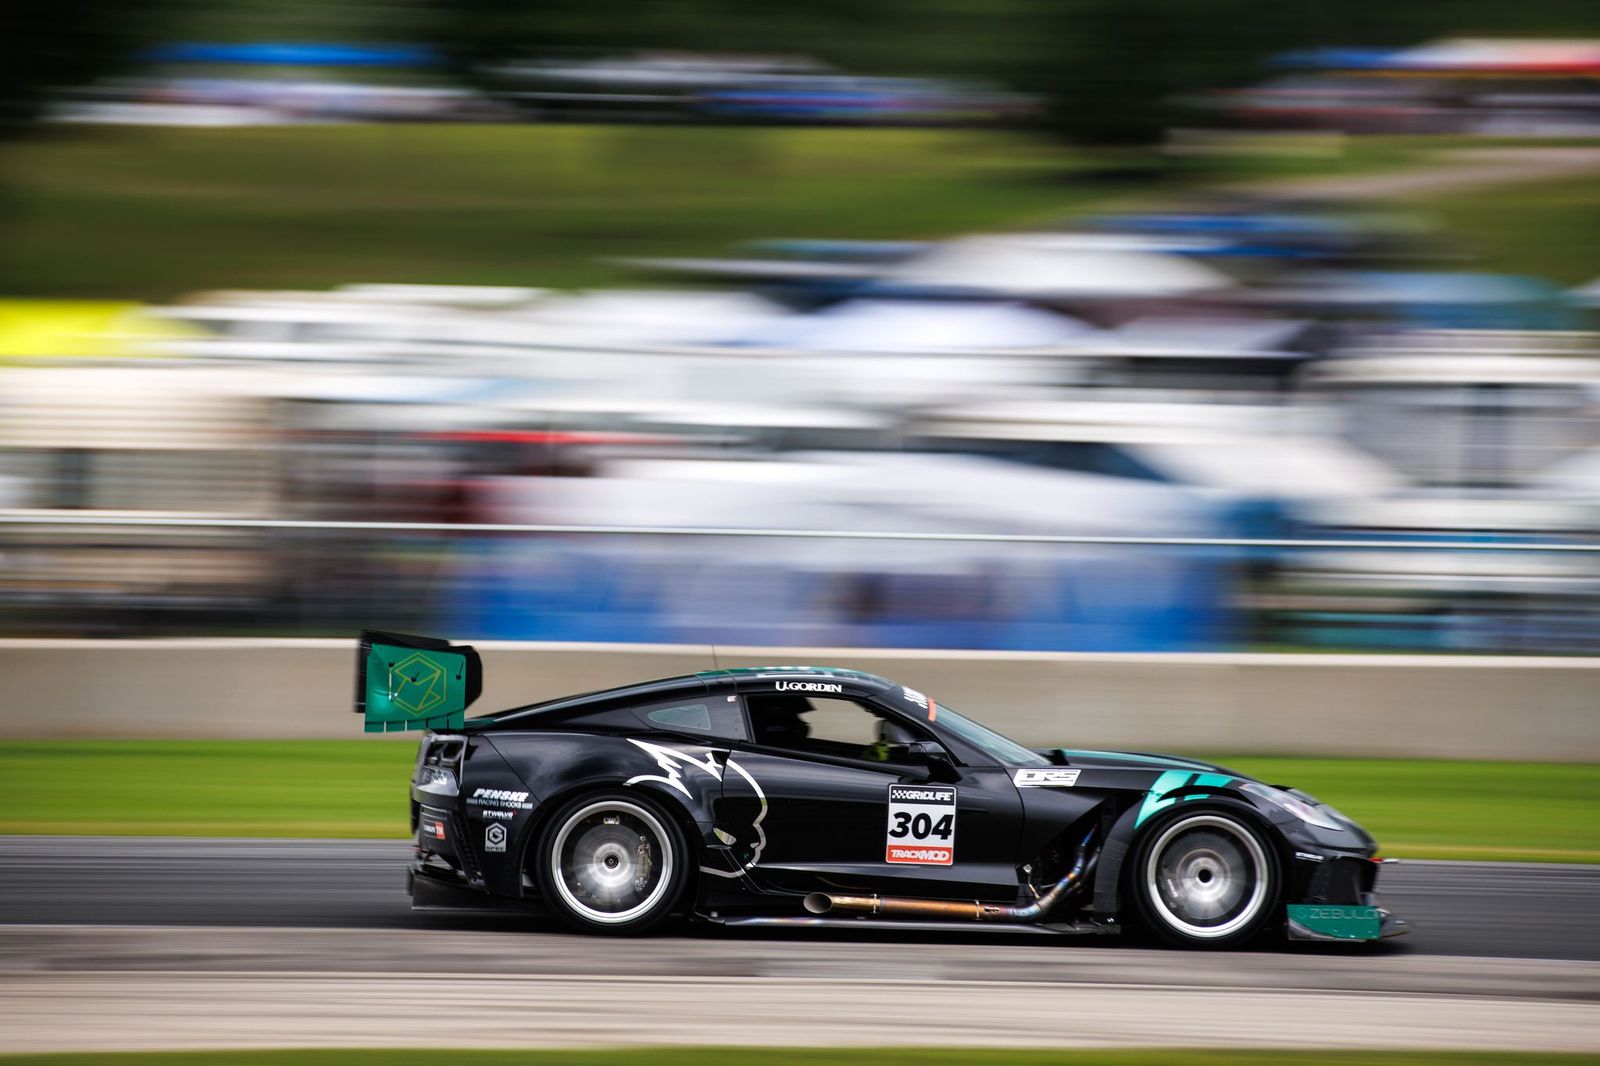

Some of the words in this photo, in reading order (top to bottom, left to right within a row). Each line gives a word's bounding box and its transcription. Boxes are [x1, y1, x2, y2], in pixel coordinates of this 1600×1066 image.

[473, 788, 529, 802] PENSKE
[905, 790, 953, 801] GRIDLIFE
[478, 798, 499, 807] RACING
[499, 801, 522, 809] SHOCKS
[888, 811, 954, 840] 304
[890, 849, 950, 861] TRACKMOD
